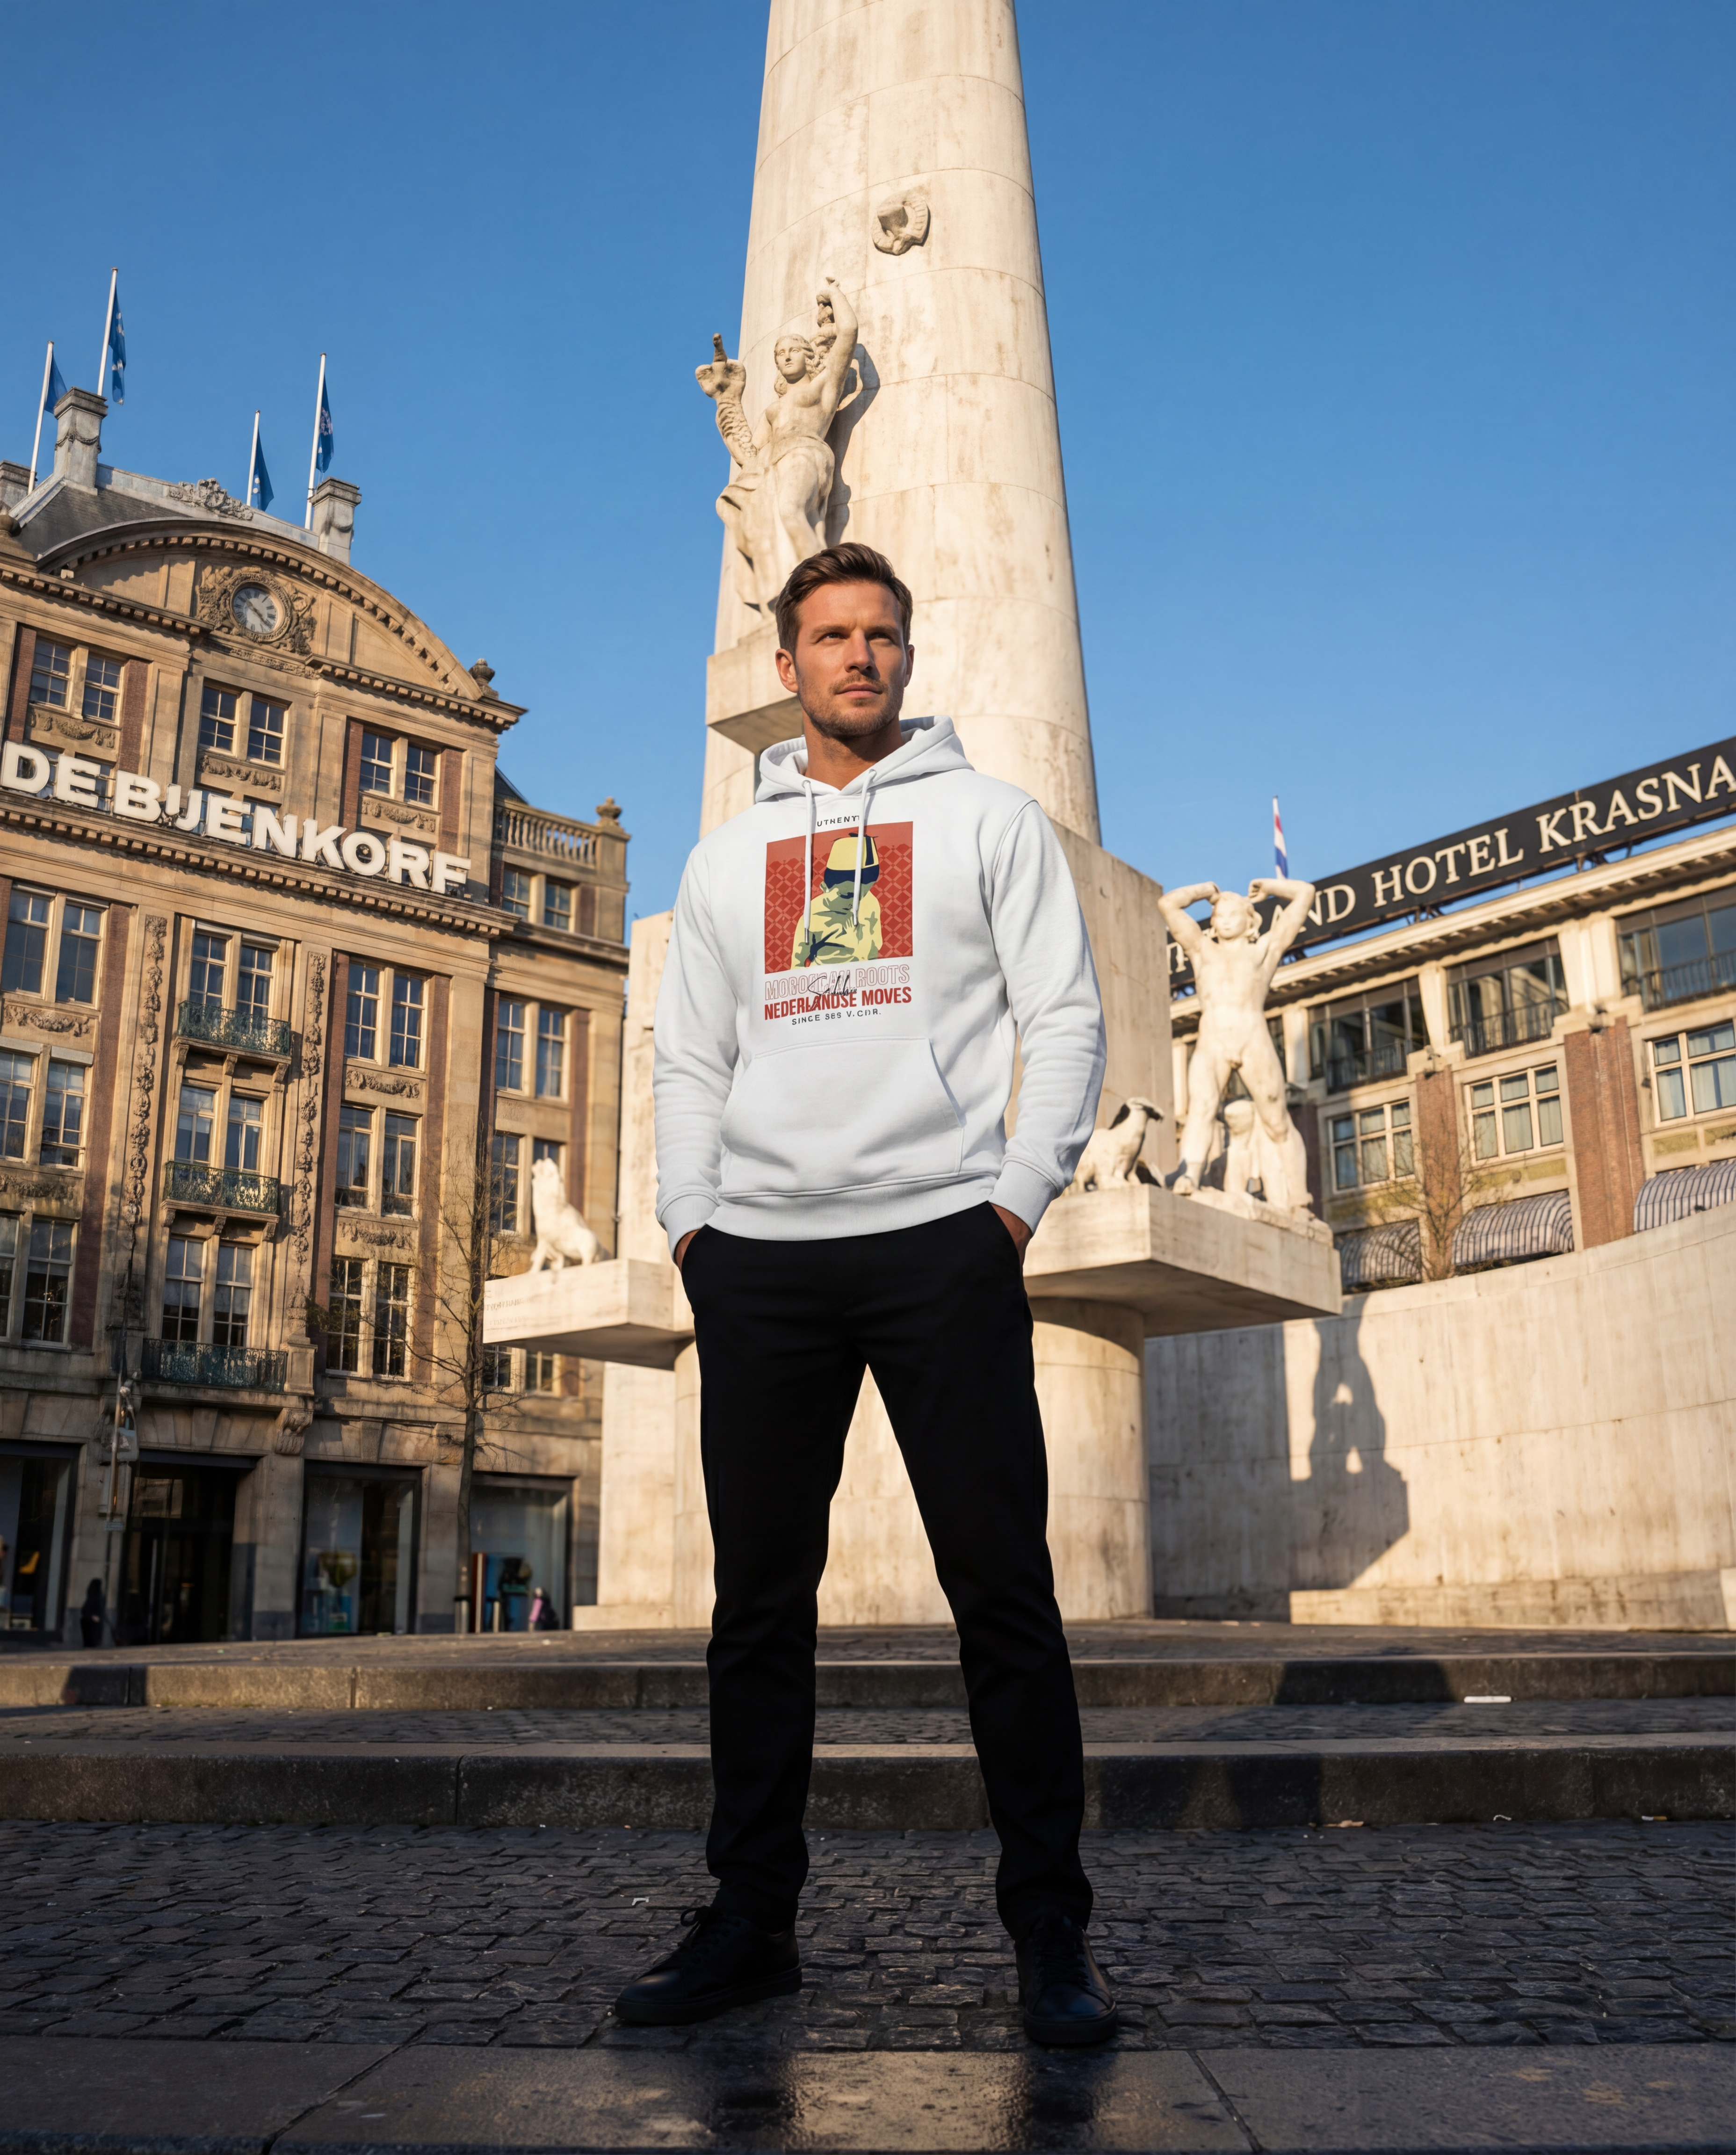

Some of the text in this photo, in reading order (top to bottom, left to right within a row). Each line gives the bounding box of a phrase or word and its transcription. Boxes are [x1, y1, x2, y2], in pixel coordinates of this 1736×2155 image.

[0, 740, 471, 894] DE BIJENKORF
[1371, 828, 1524, 908] HOTEL
[1536, 755, 1736, 853] KRASNA
[855, 964, 910, 988] ROOTS
[764, 991, 857, 1020] NEDERLANDSE
[861, 986, 912, 1006] MOVES
[792, 1014, 820, 1025] SINCE
